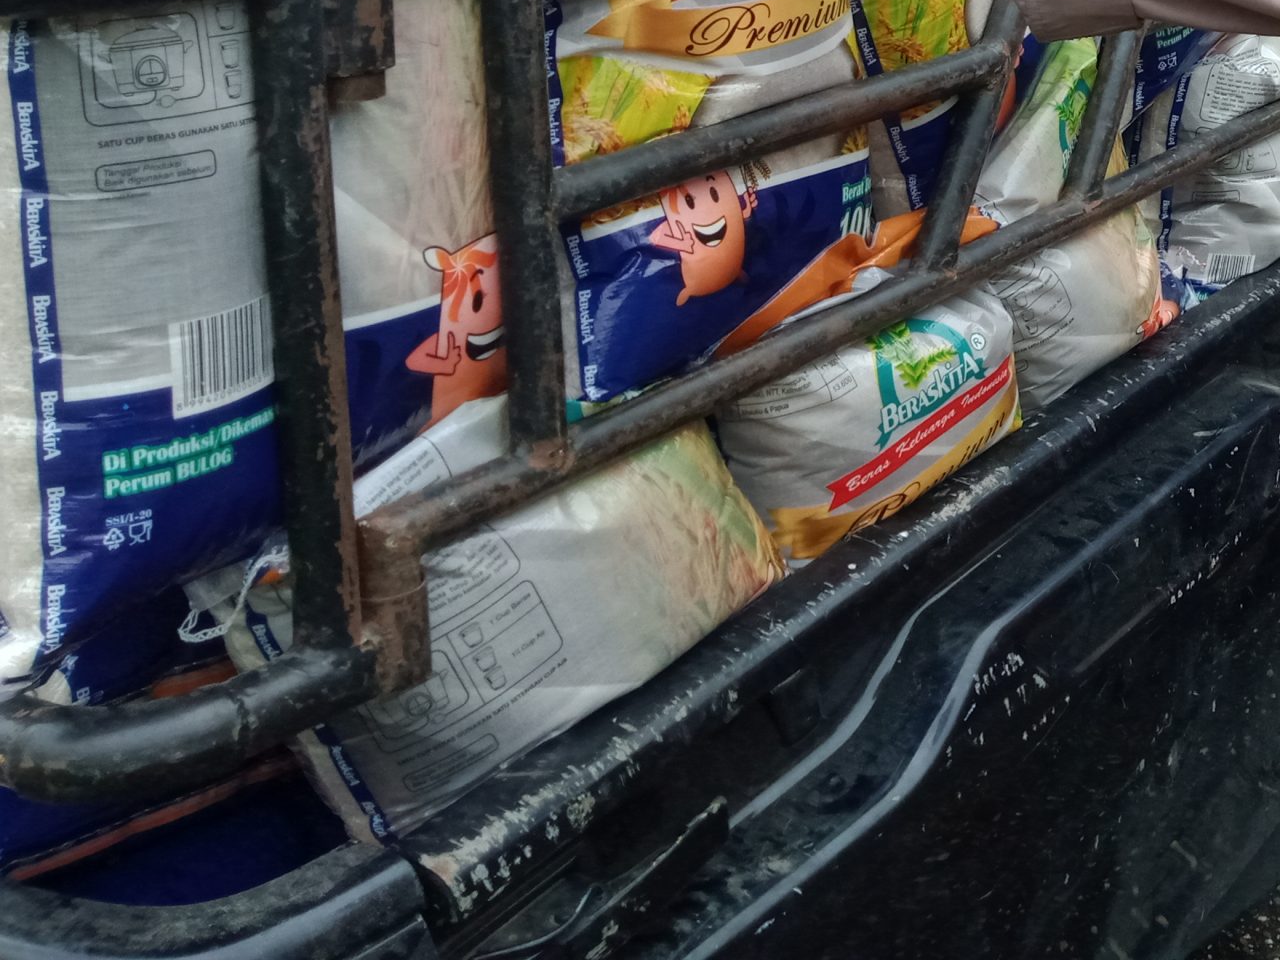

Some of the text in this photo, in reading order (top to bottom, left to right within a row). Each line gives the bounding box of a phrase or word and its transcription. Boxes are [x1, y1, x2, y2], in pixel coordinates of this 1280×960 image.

[103, 451, 128, 472] Di
[105, 447, 234, 498] Perum BULOG
[845, 458, 892, 492] Beras
[895, 408, 957, 458] Keluarga
